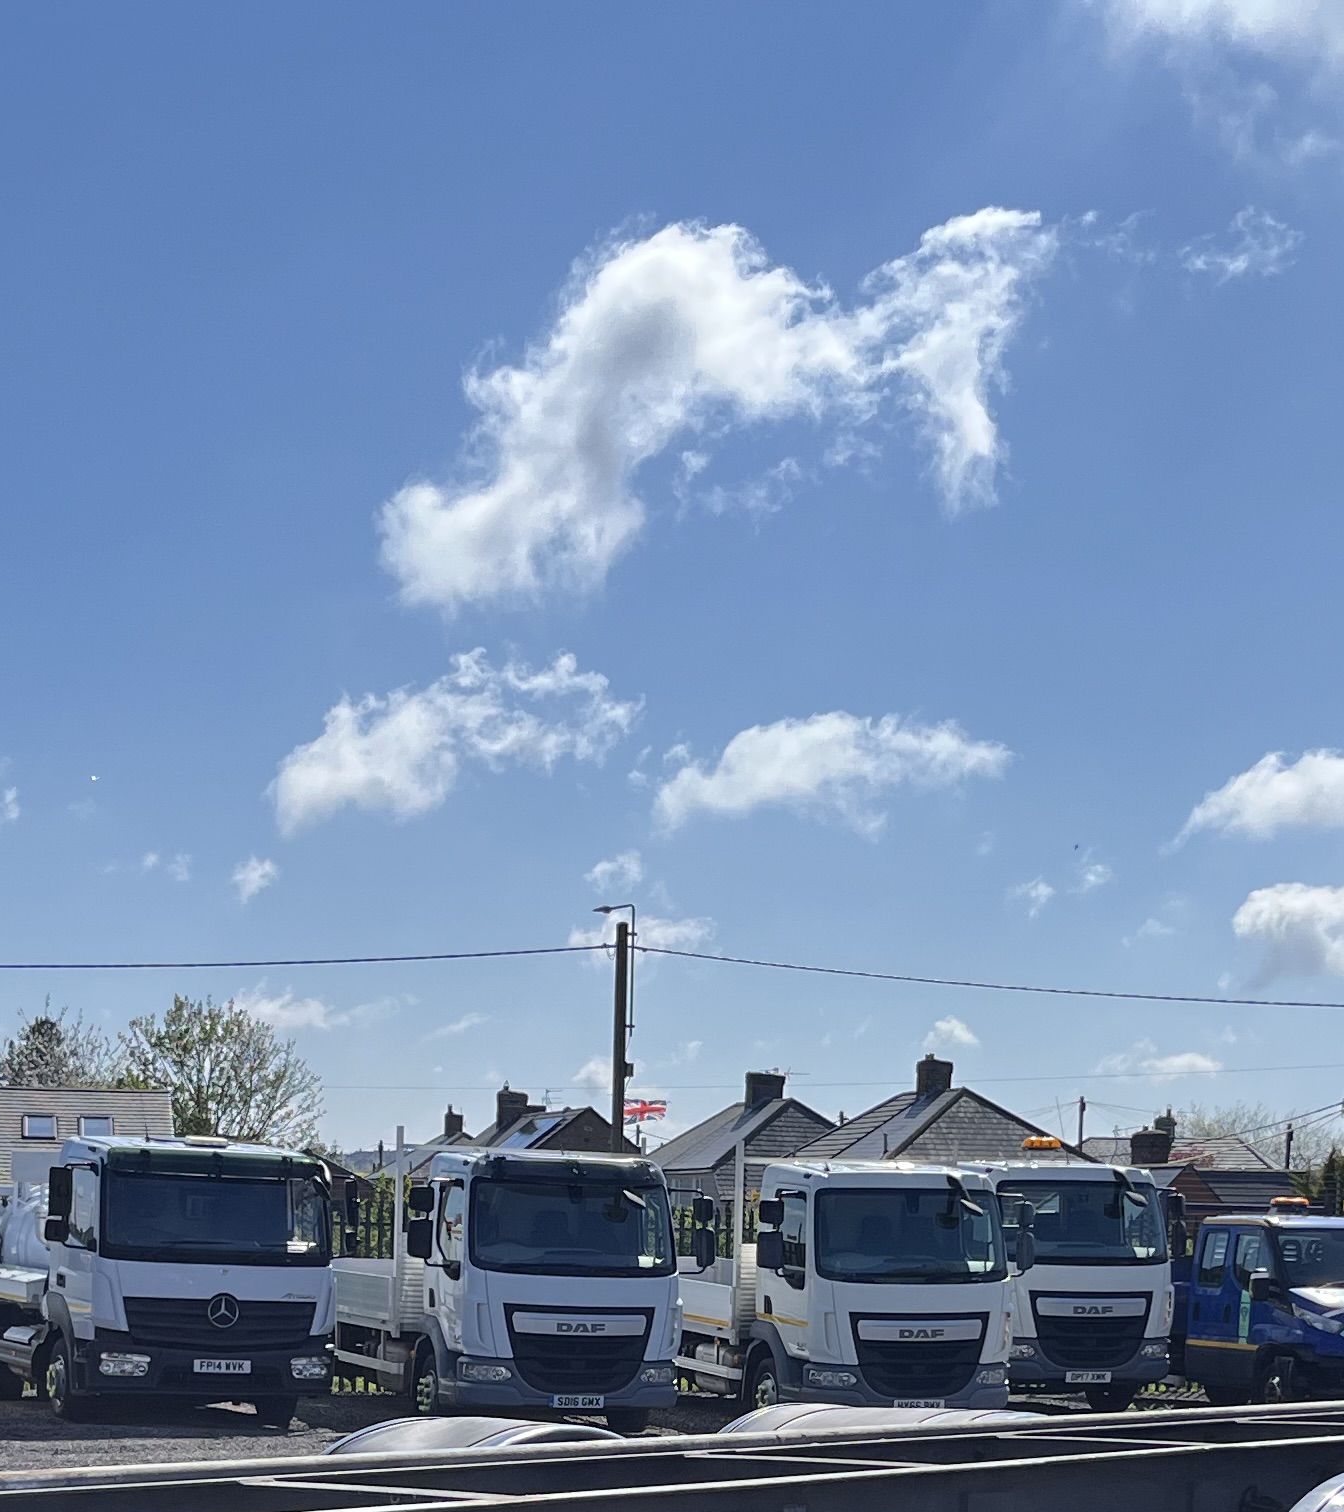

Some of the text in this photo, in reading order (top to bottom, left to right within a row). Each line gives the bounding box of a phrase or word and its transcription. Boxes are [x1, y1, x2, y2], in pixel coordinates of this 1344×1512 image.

[1072, 1305, 1114, 1315] DAF
[556, 1322, 606, 1333] DAF
[898, 1329, 945, 1339] DAF
[199, 1360, 245, 1372] FP14 WVK
[557, 1396, 601, 1407] SD16 GMX
